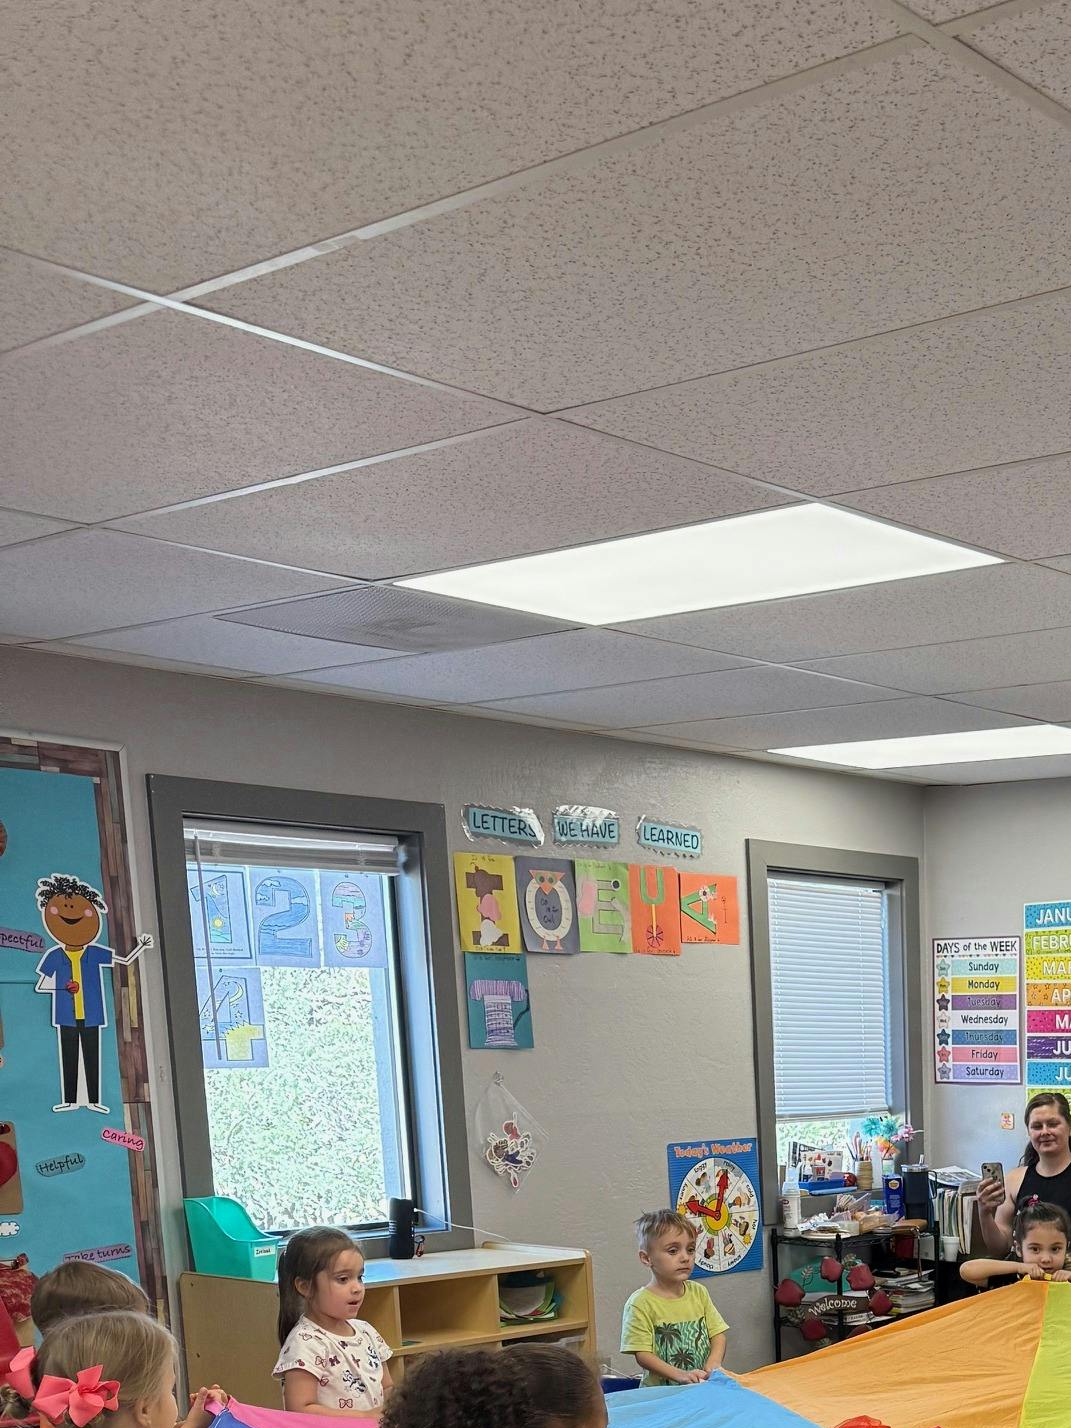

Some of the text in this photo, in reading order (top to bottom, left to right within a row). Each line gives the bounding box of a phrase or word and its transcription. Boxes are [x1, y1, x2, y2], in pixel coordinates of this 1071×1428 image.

[473, 811, 537, 838] LETTERS
[558, 819, 615, 839] WE HAVE
[644, 825, 699, 849] LEARNED
[936, 940, 1017, 954] DAYS of the WEEK
[968, 962, 999, 972] Sunday
[968, 980, 1000, 990] Monday
[967, 998, 1000, 1007] Tuesday
[961, 1015, 1008, 1026] Wednesday
[971, 1050, 998, 1060] Friday
[966, 1067, 1004, 1077] Saturday
[38, 1155, 84, 1174] Helpful
[97, 1245, 131, 1258] turns
[808, 1298, 858, 1317] Welcome
